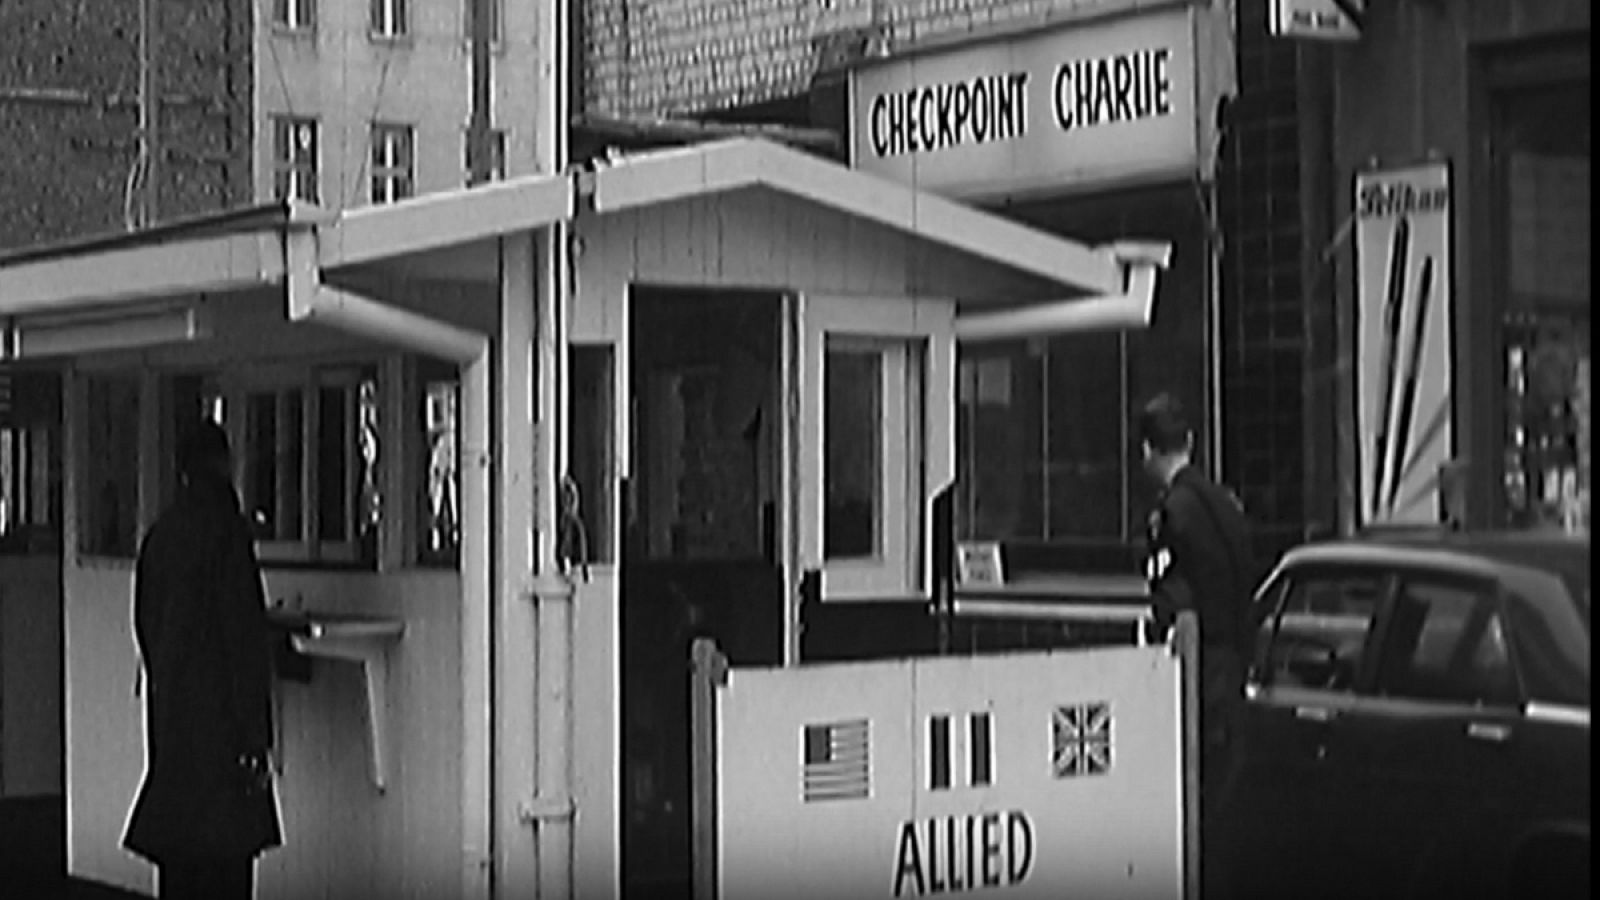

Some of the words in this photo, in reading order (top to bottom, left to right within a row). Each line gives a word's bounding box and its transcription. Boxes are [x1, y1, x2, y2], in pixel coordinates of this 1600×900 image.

[871, 72, 1027, 157] CHECKPOINT
[1055, 48, 1169, 130] CHARLIE
[894, 811, 1033, 897] ALLIED
